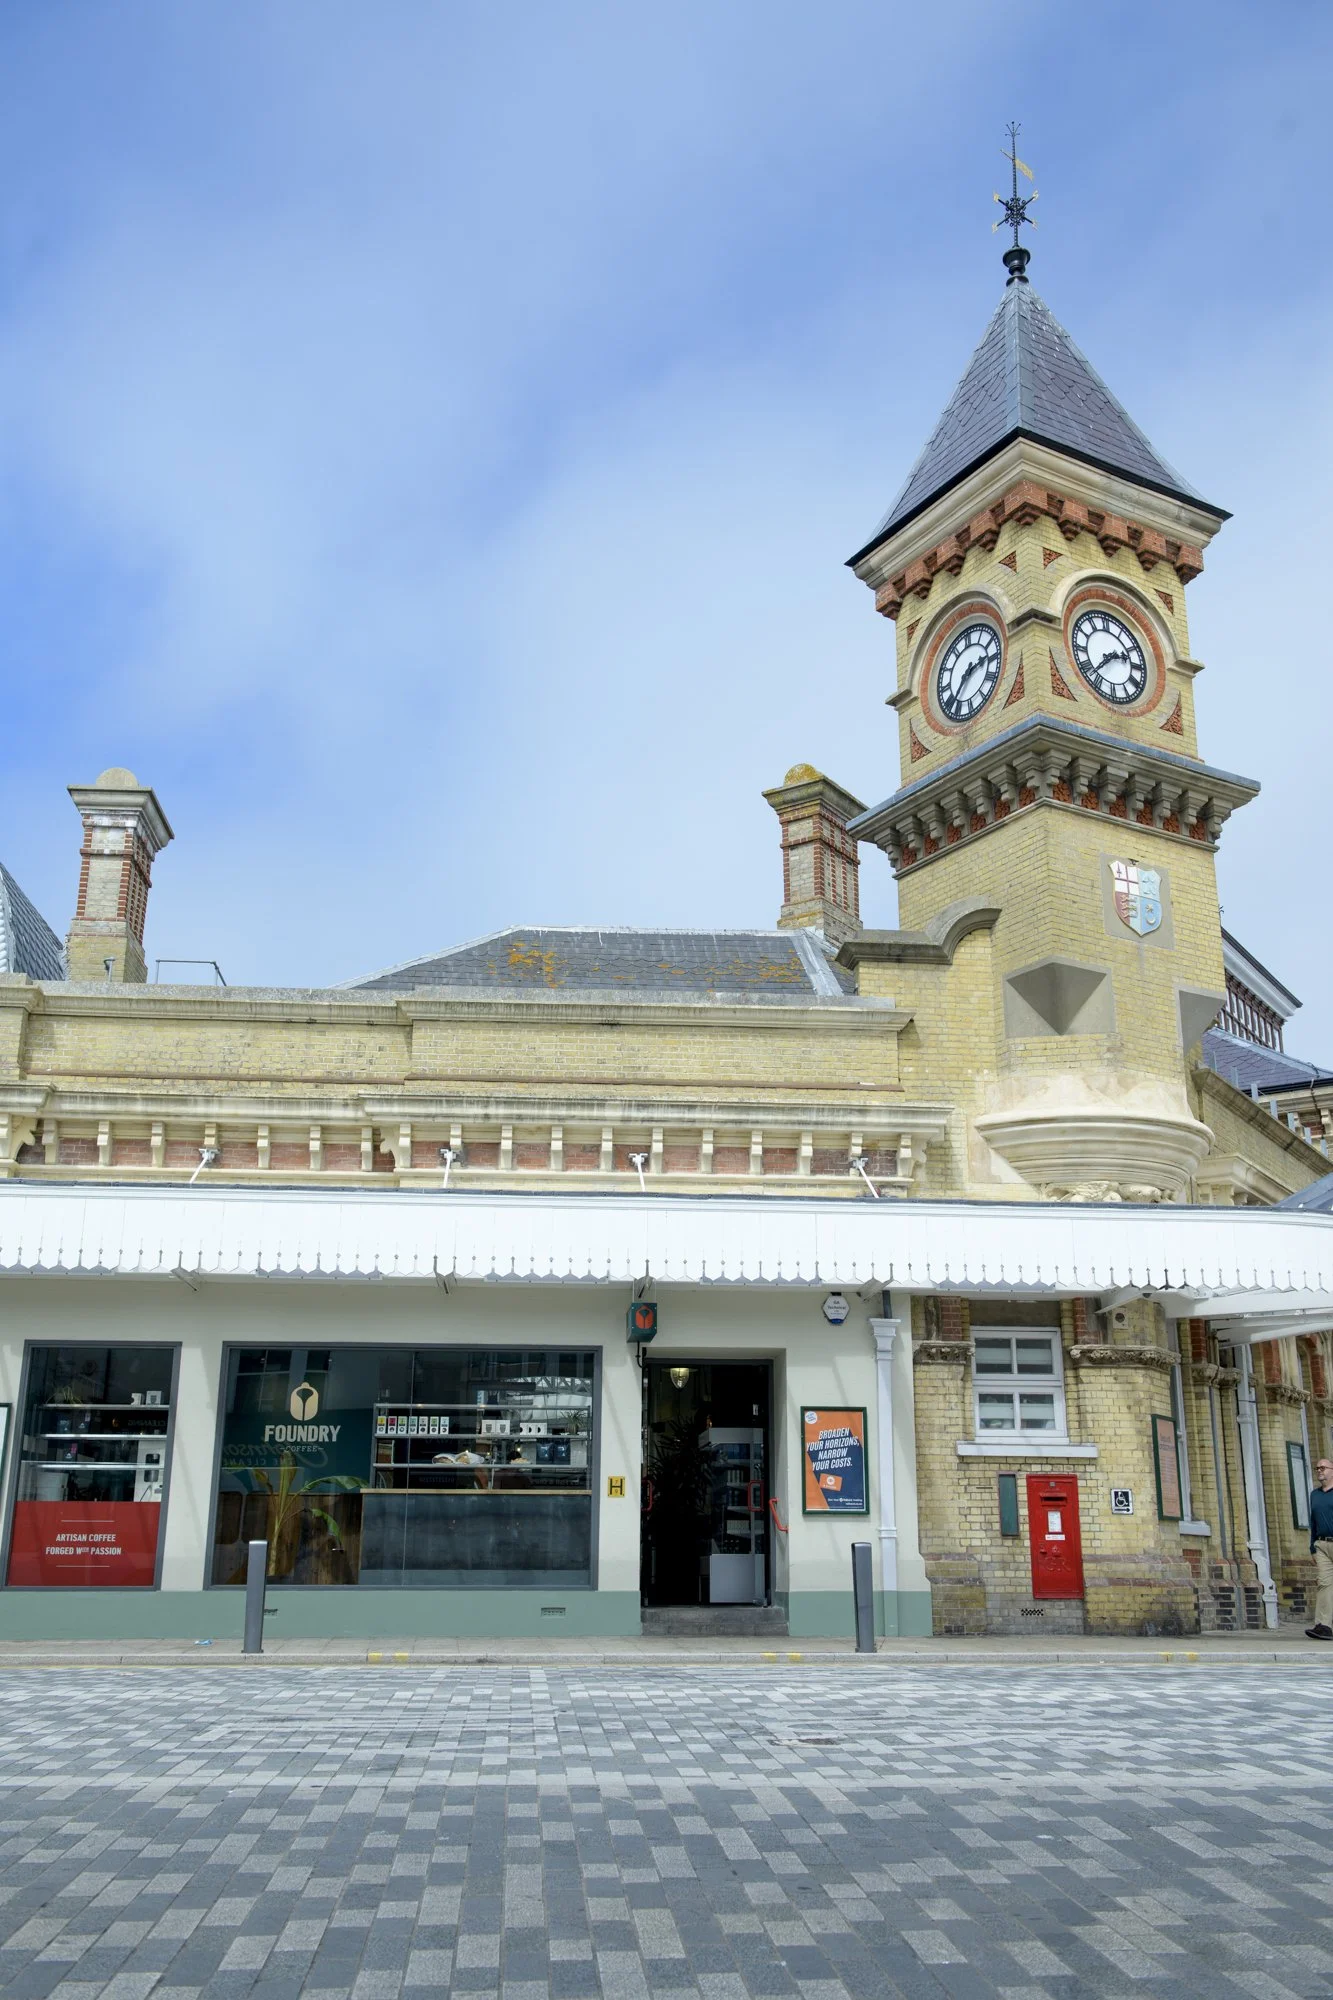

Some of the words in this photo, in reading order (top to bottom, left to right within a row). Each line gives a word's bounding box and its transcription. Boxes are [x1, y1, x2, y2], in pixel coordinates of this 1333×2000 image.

[264, 1425, 341, 1442] FOUNDRY
[819, 1428, 850, 1440] BROADEN
[806, 1440, 824, 1451] YOUR
[825, 1436, 859, 1450] HORIZONS,
[818, 1448, 848, 1460] NARROW
[812, 1460, 830, 1471] YOUR
[831, 1457, 853, 1469] COSTS.
[56, 1533, 87, 1541] ARTISAN
[88, 1533, 116, 1541] COFFEE
[46, 1546, 74, 1555] FORGED
[91, 1546, 122, 1555] PASSION
